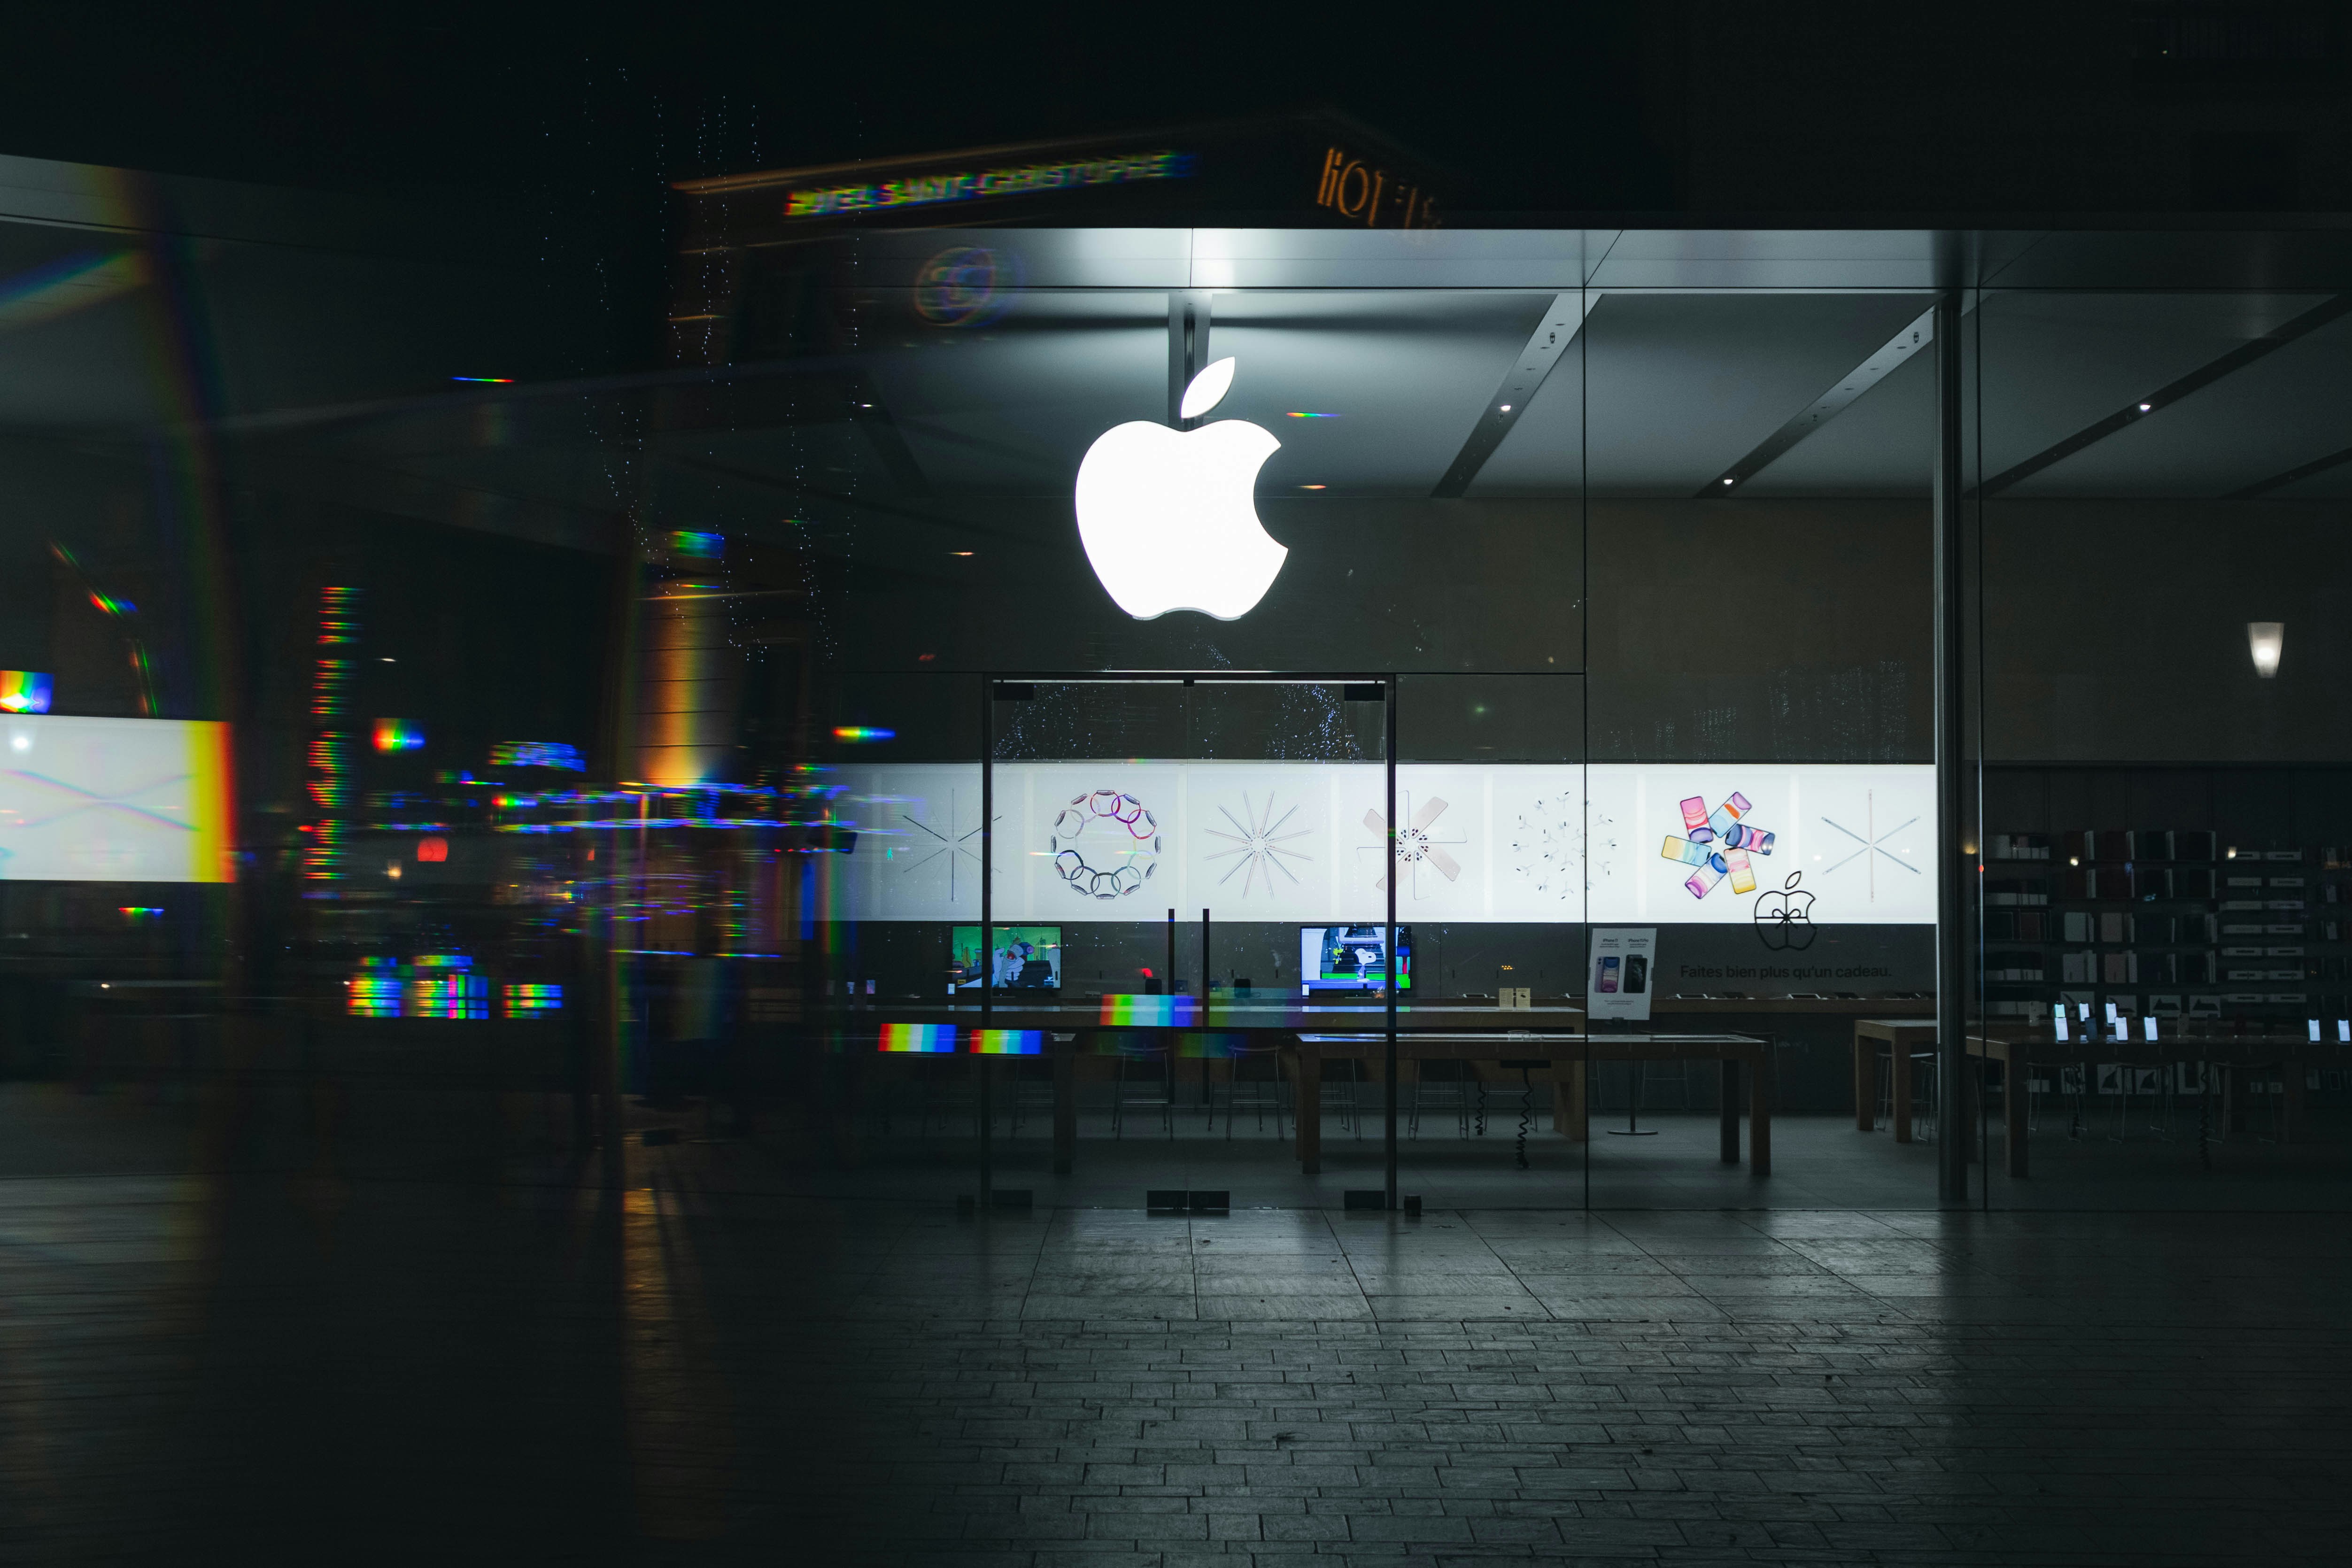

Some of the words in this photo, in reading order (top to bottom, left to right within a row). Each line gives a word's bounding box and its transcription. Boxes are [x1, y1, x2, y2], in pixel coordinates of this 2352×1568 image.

[1680, 965, 1722, 978] Faites
[1726, 965, 1756, 978] bien
[1760, 966, 1789, 980] plus
[1793, 965, 1832, 980] qu'un
[1836, 965, 1892, 977] cadeau.
